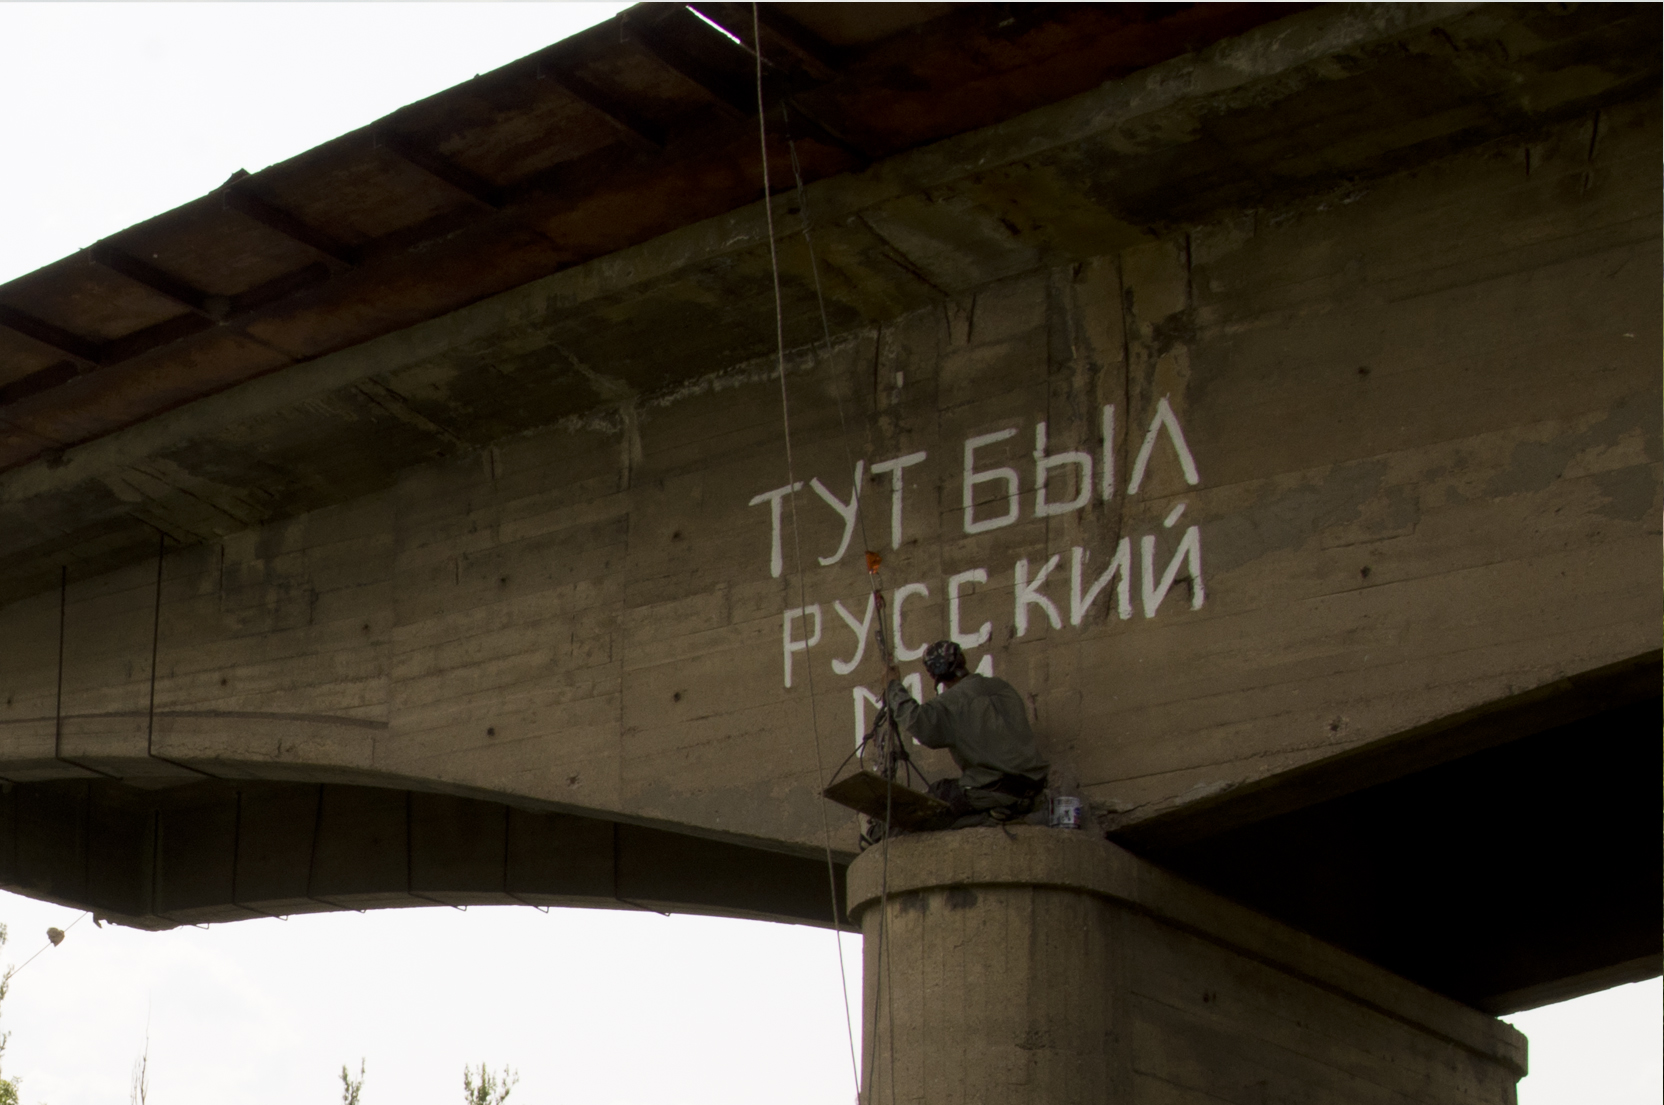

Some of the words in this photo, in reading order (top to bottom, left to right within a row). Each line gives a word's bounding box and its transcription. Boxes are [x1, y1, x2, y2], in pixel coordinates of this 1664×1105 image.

[748, 450, 927, 578] ТУТ
[963, 394, 1199, 534] БЫЛ
[782, 503, 1204, 688] РУССКИЙ
